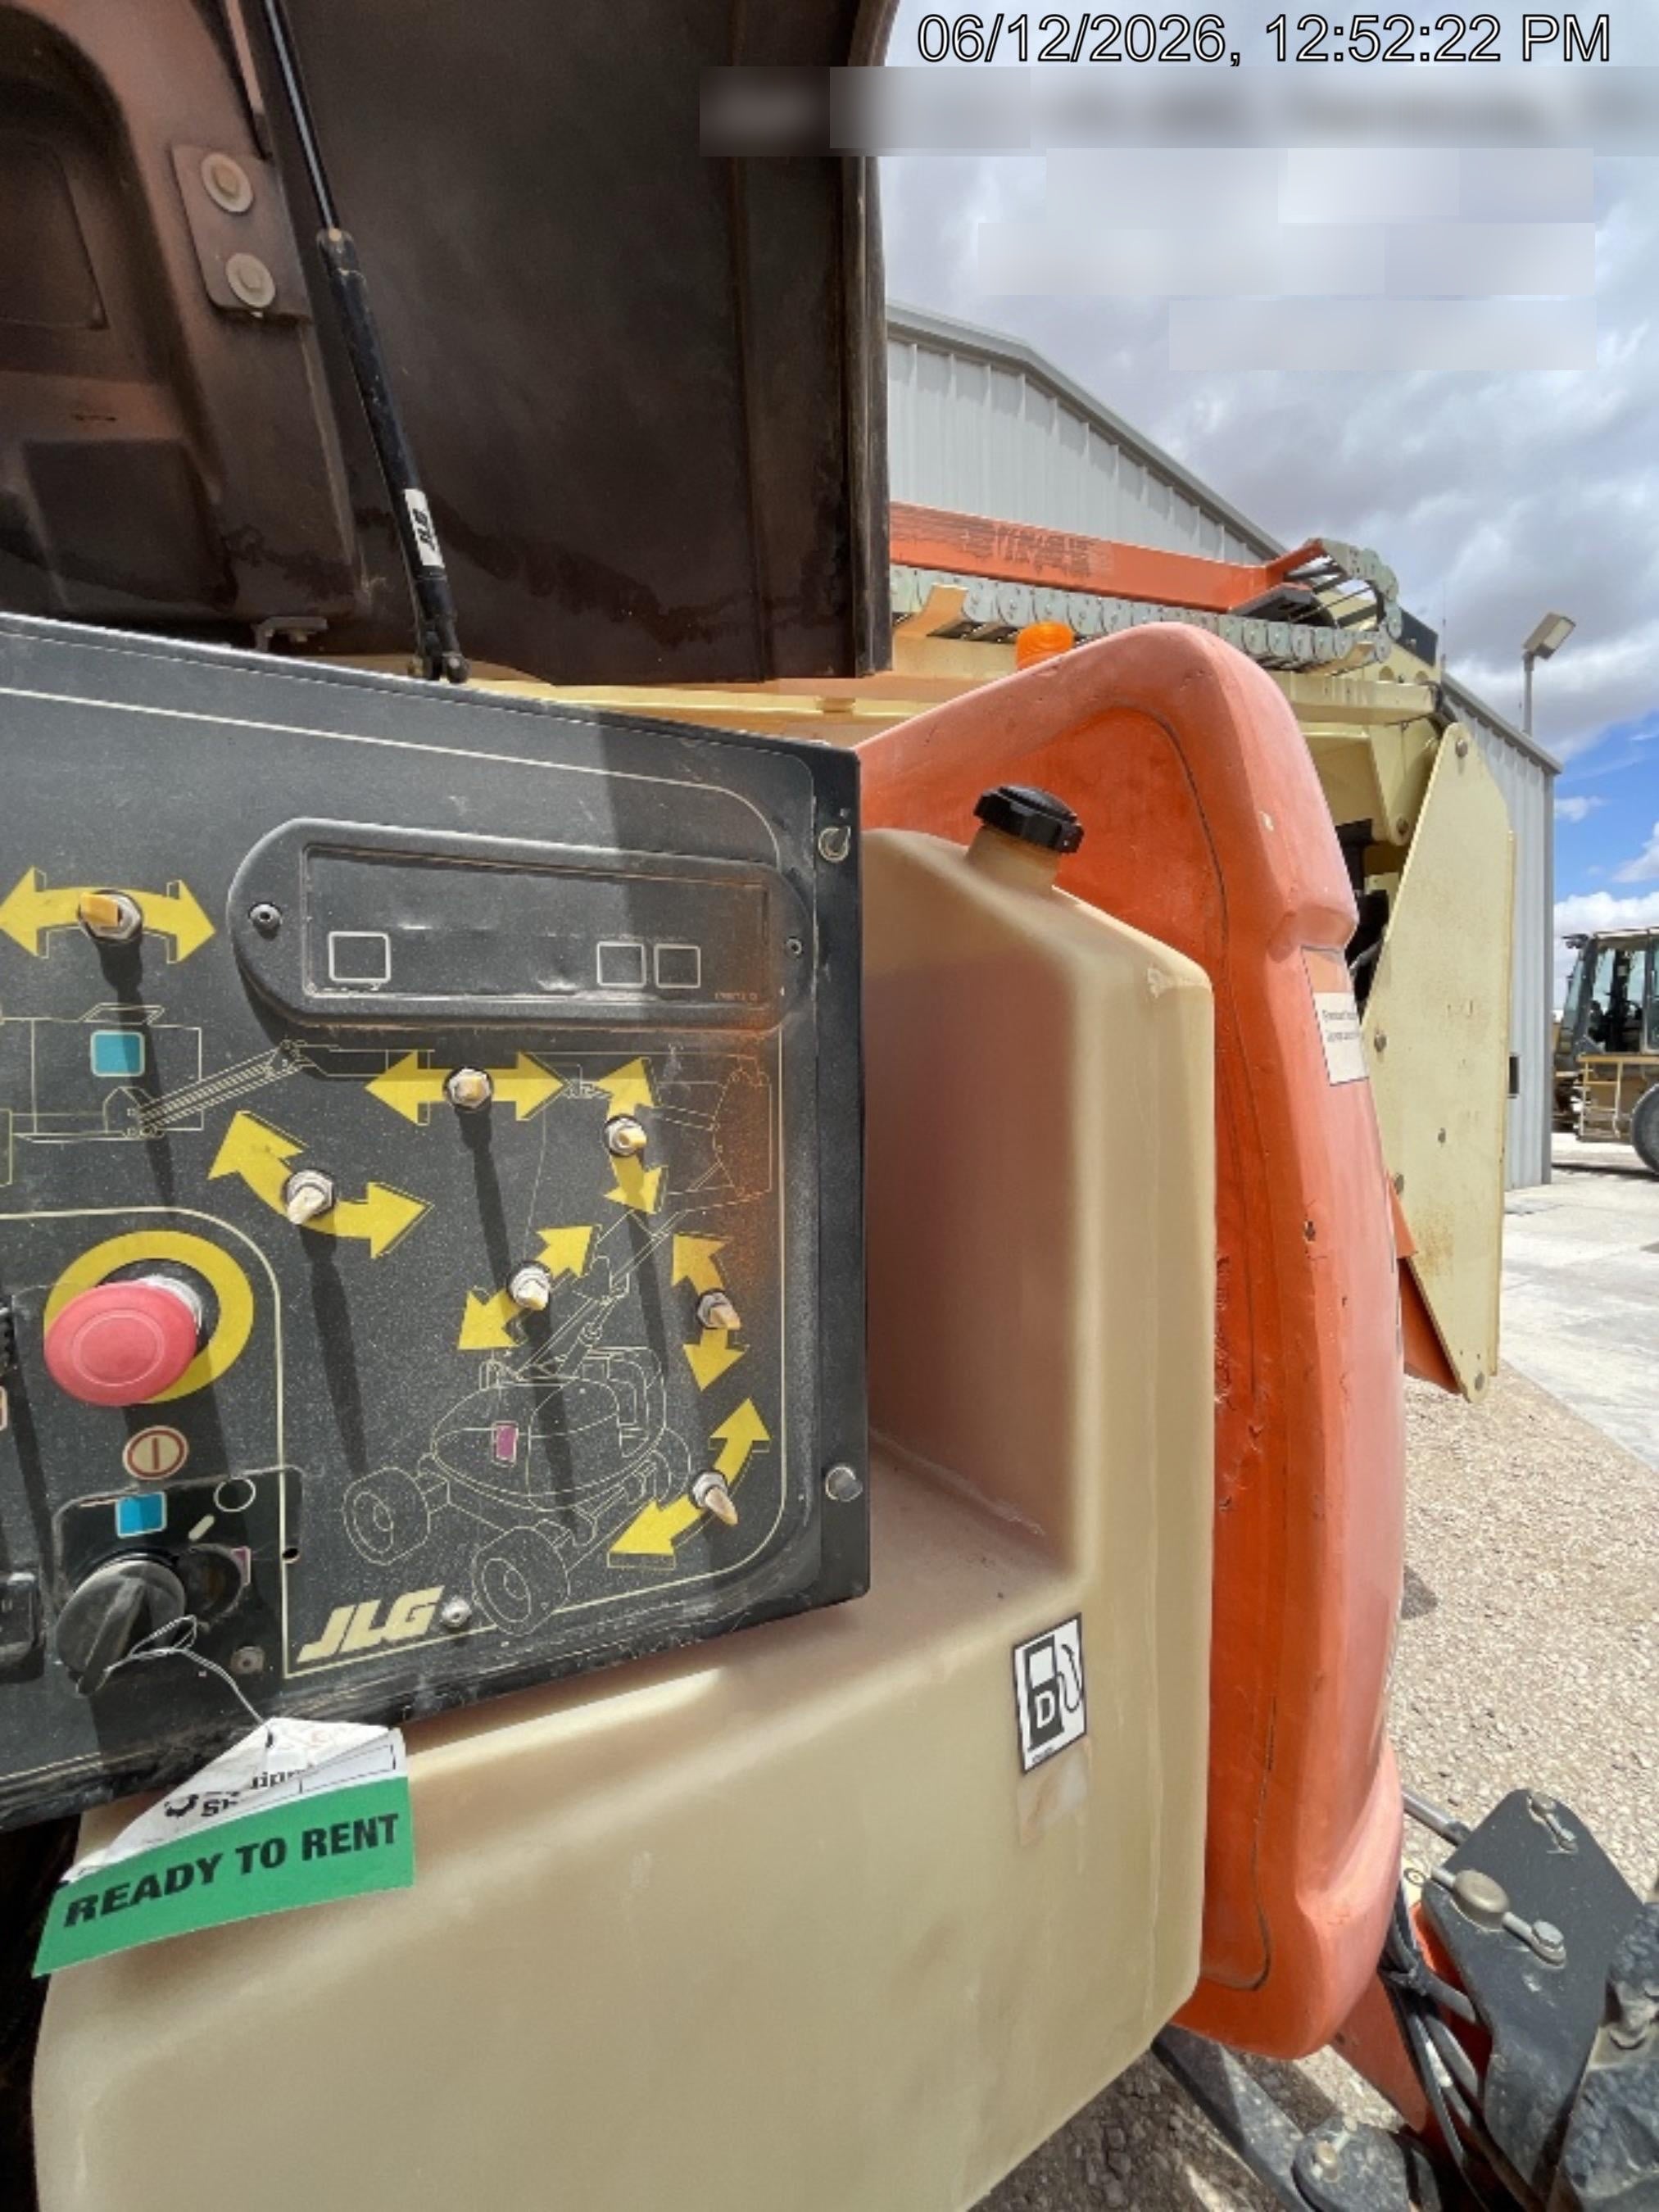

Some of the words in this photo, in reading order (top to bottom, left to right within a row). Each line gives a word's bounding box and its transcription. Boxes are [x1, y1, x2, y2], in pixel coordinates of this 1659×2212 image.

[297, 1584, 445, 1663] JLG
[1035, 1689, 1056, 1729] D
[63, 1853, 224, 1928] READY
[235, 1838, 288, 1874] TO
[301, 1814, 399, 1861] RENT
